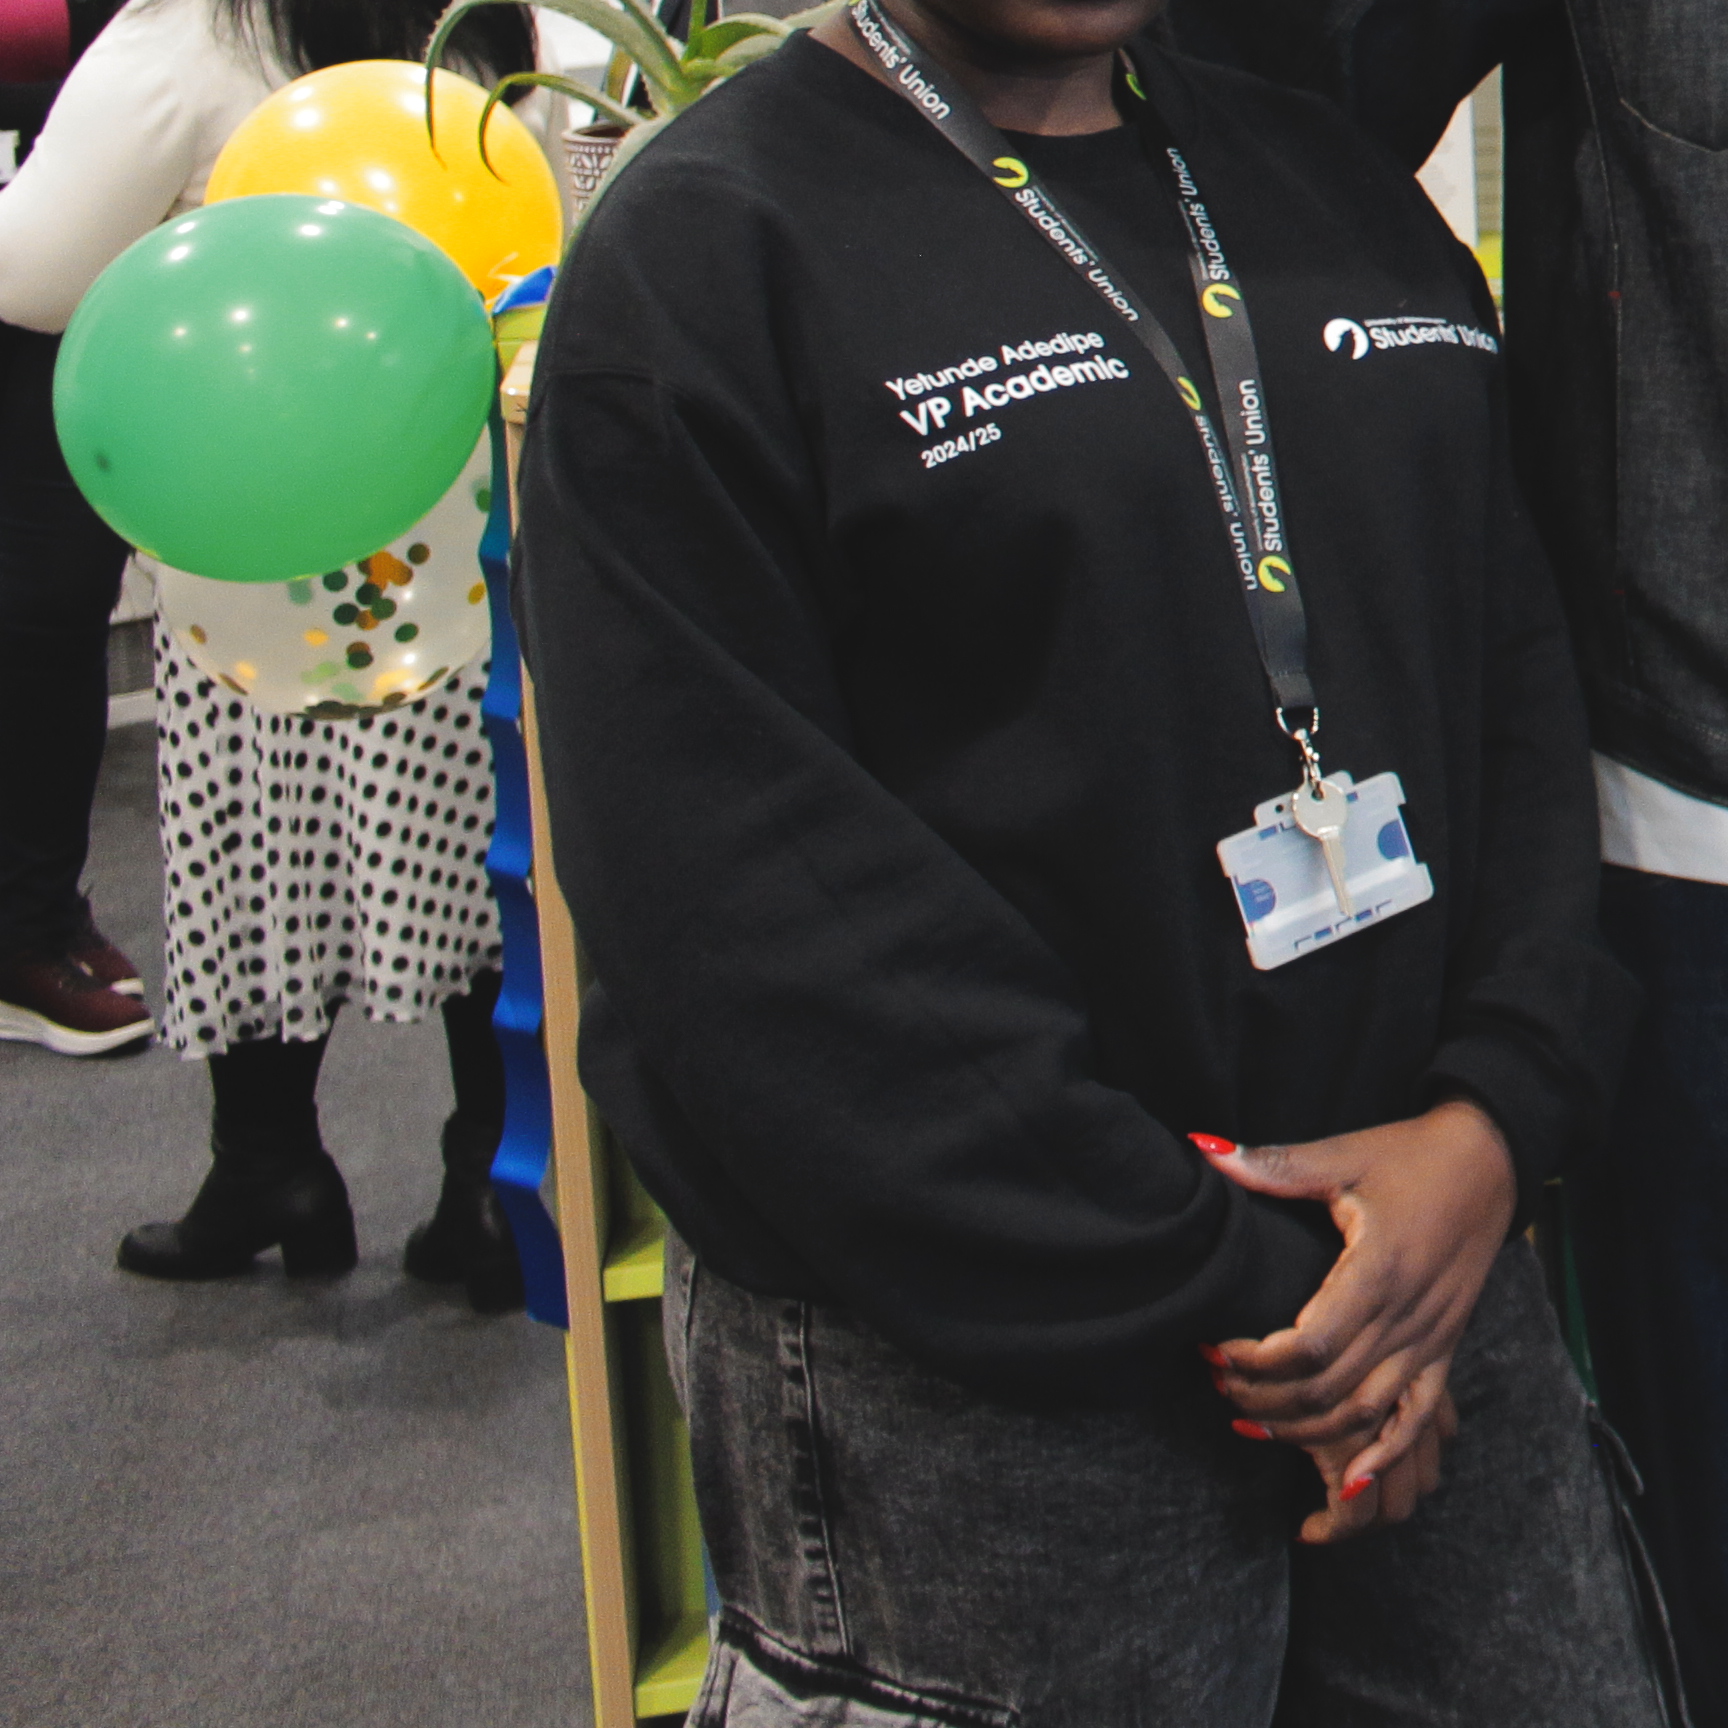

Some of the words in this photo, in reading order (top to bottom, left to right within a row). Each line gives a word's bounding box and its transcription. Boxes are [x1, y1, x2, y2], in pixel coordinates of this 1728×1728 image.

[899, 63, 951, 120] Union
[1166, 146, 1199, 197] Union
[1014, 187, 1096, 266] Students'
[1088, 267, 1140, 323] Union
[884, 355, 998, 401] Yetunde
[1000, 332, 1105, 365] Adedipe
[899, 396, 952, 437] VP
[960, 354, 1131, 418] Academic
[920, 422, 1002, 469] 2024/25
[1238, 378, 1267, 445] Union
[1248, 449, 1283, 552] Students'
[1229, 521, 1259, 591] Union
